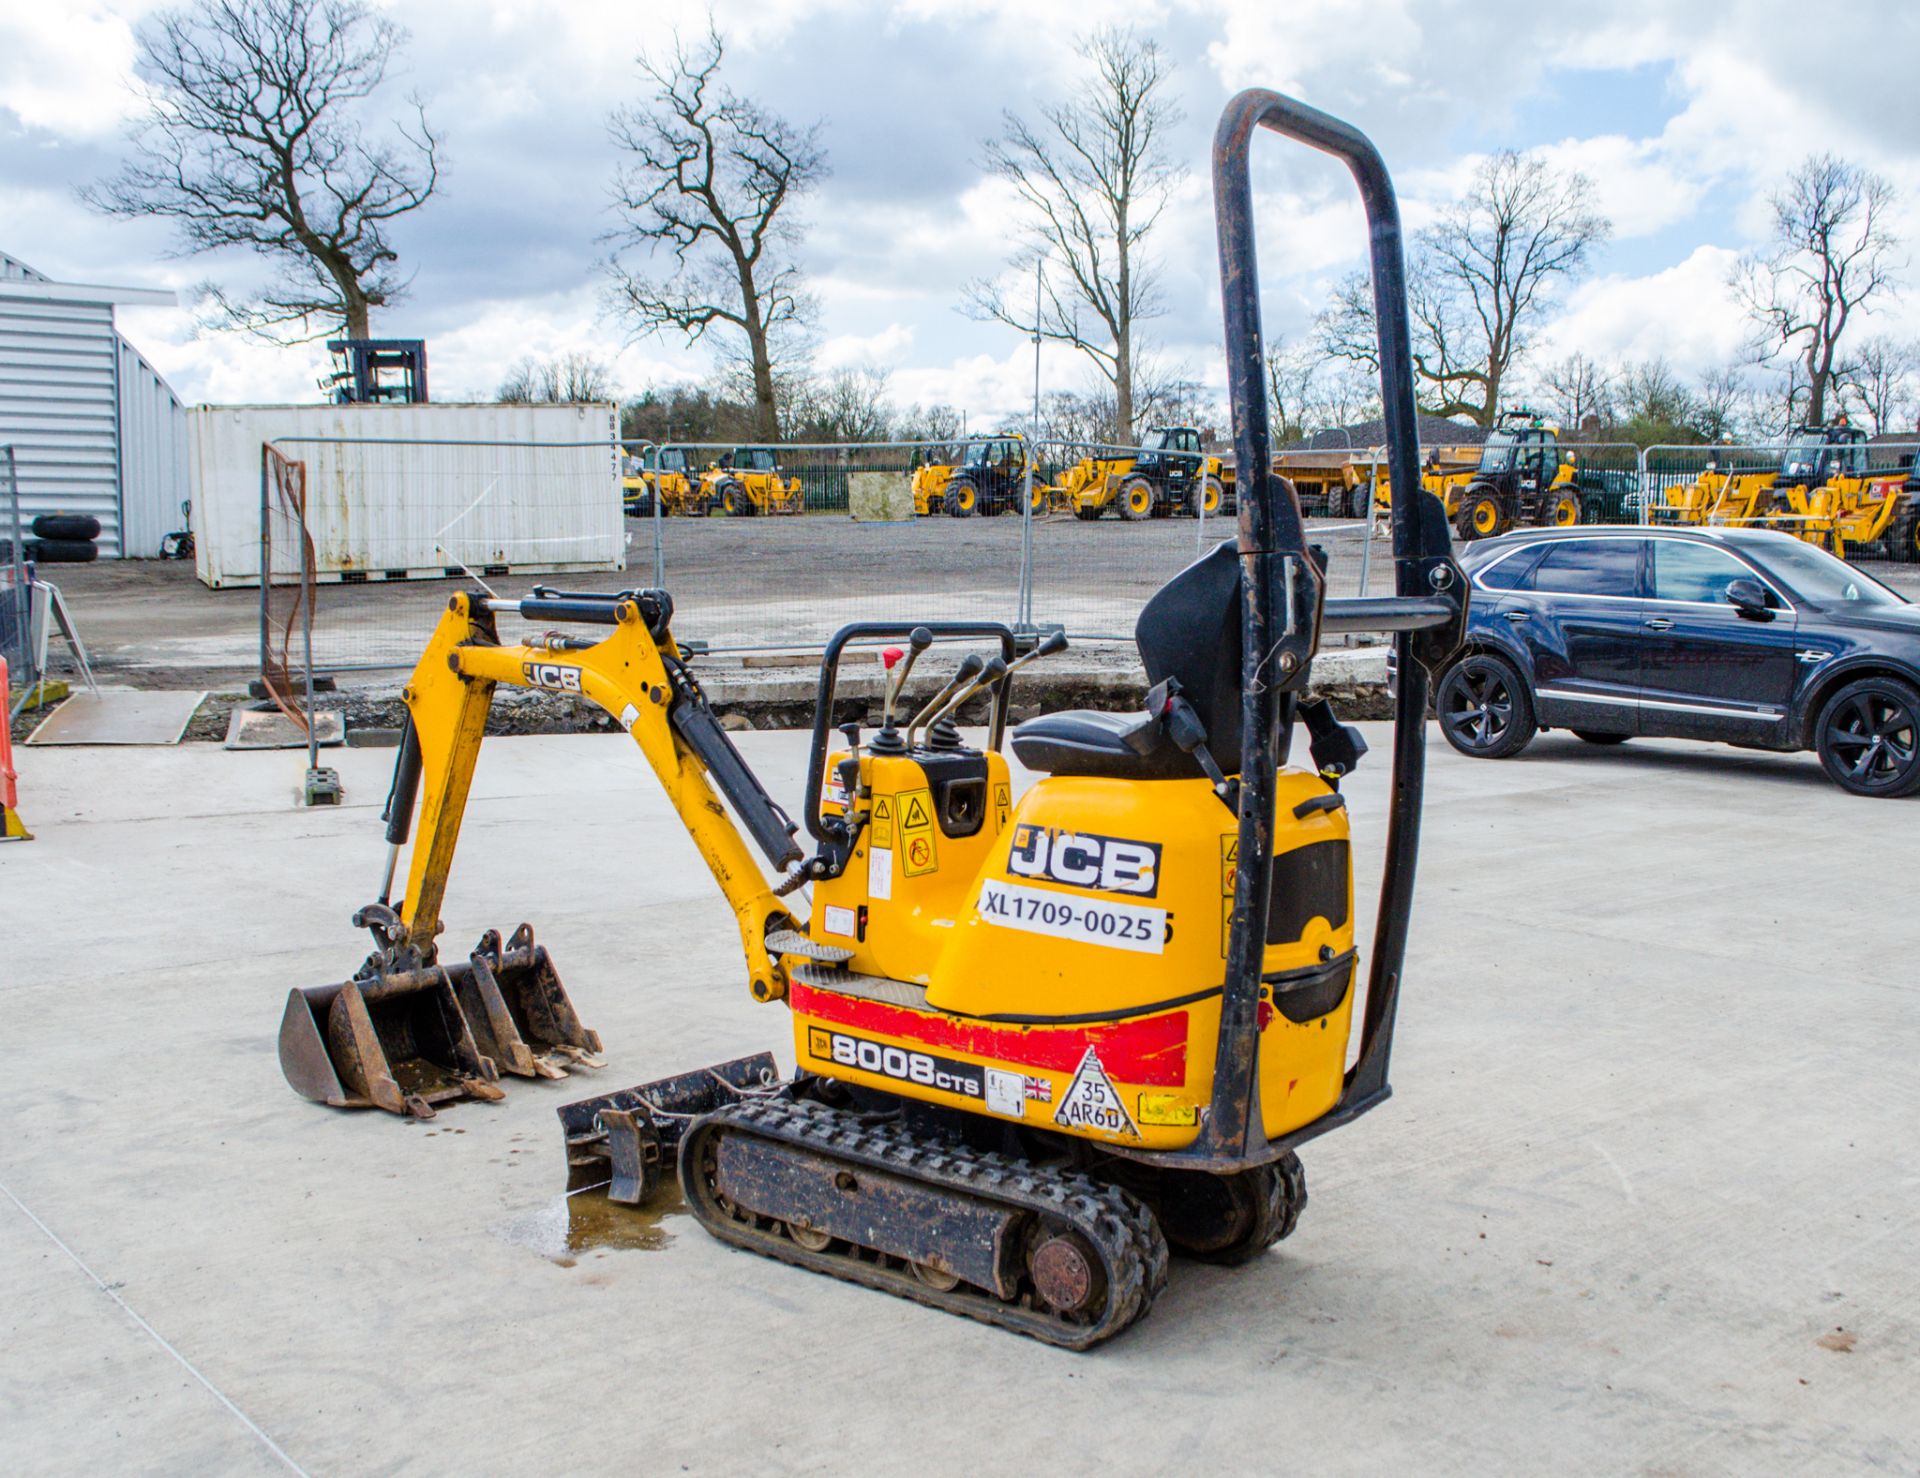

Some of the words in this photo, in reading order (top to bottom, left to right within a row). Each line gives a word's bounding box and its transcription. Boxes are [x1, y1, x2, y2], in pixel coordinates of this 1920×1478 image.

[526, 665, 581, 691] JCB
[1010, 830, 1156, 893] JCB
[984, 890, 1152, 941] XL1709-0025
[1082, 1080, 1105, 1104] 35
